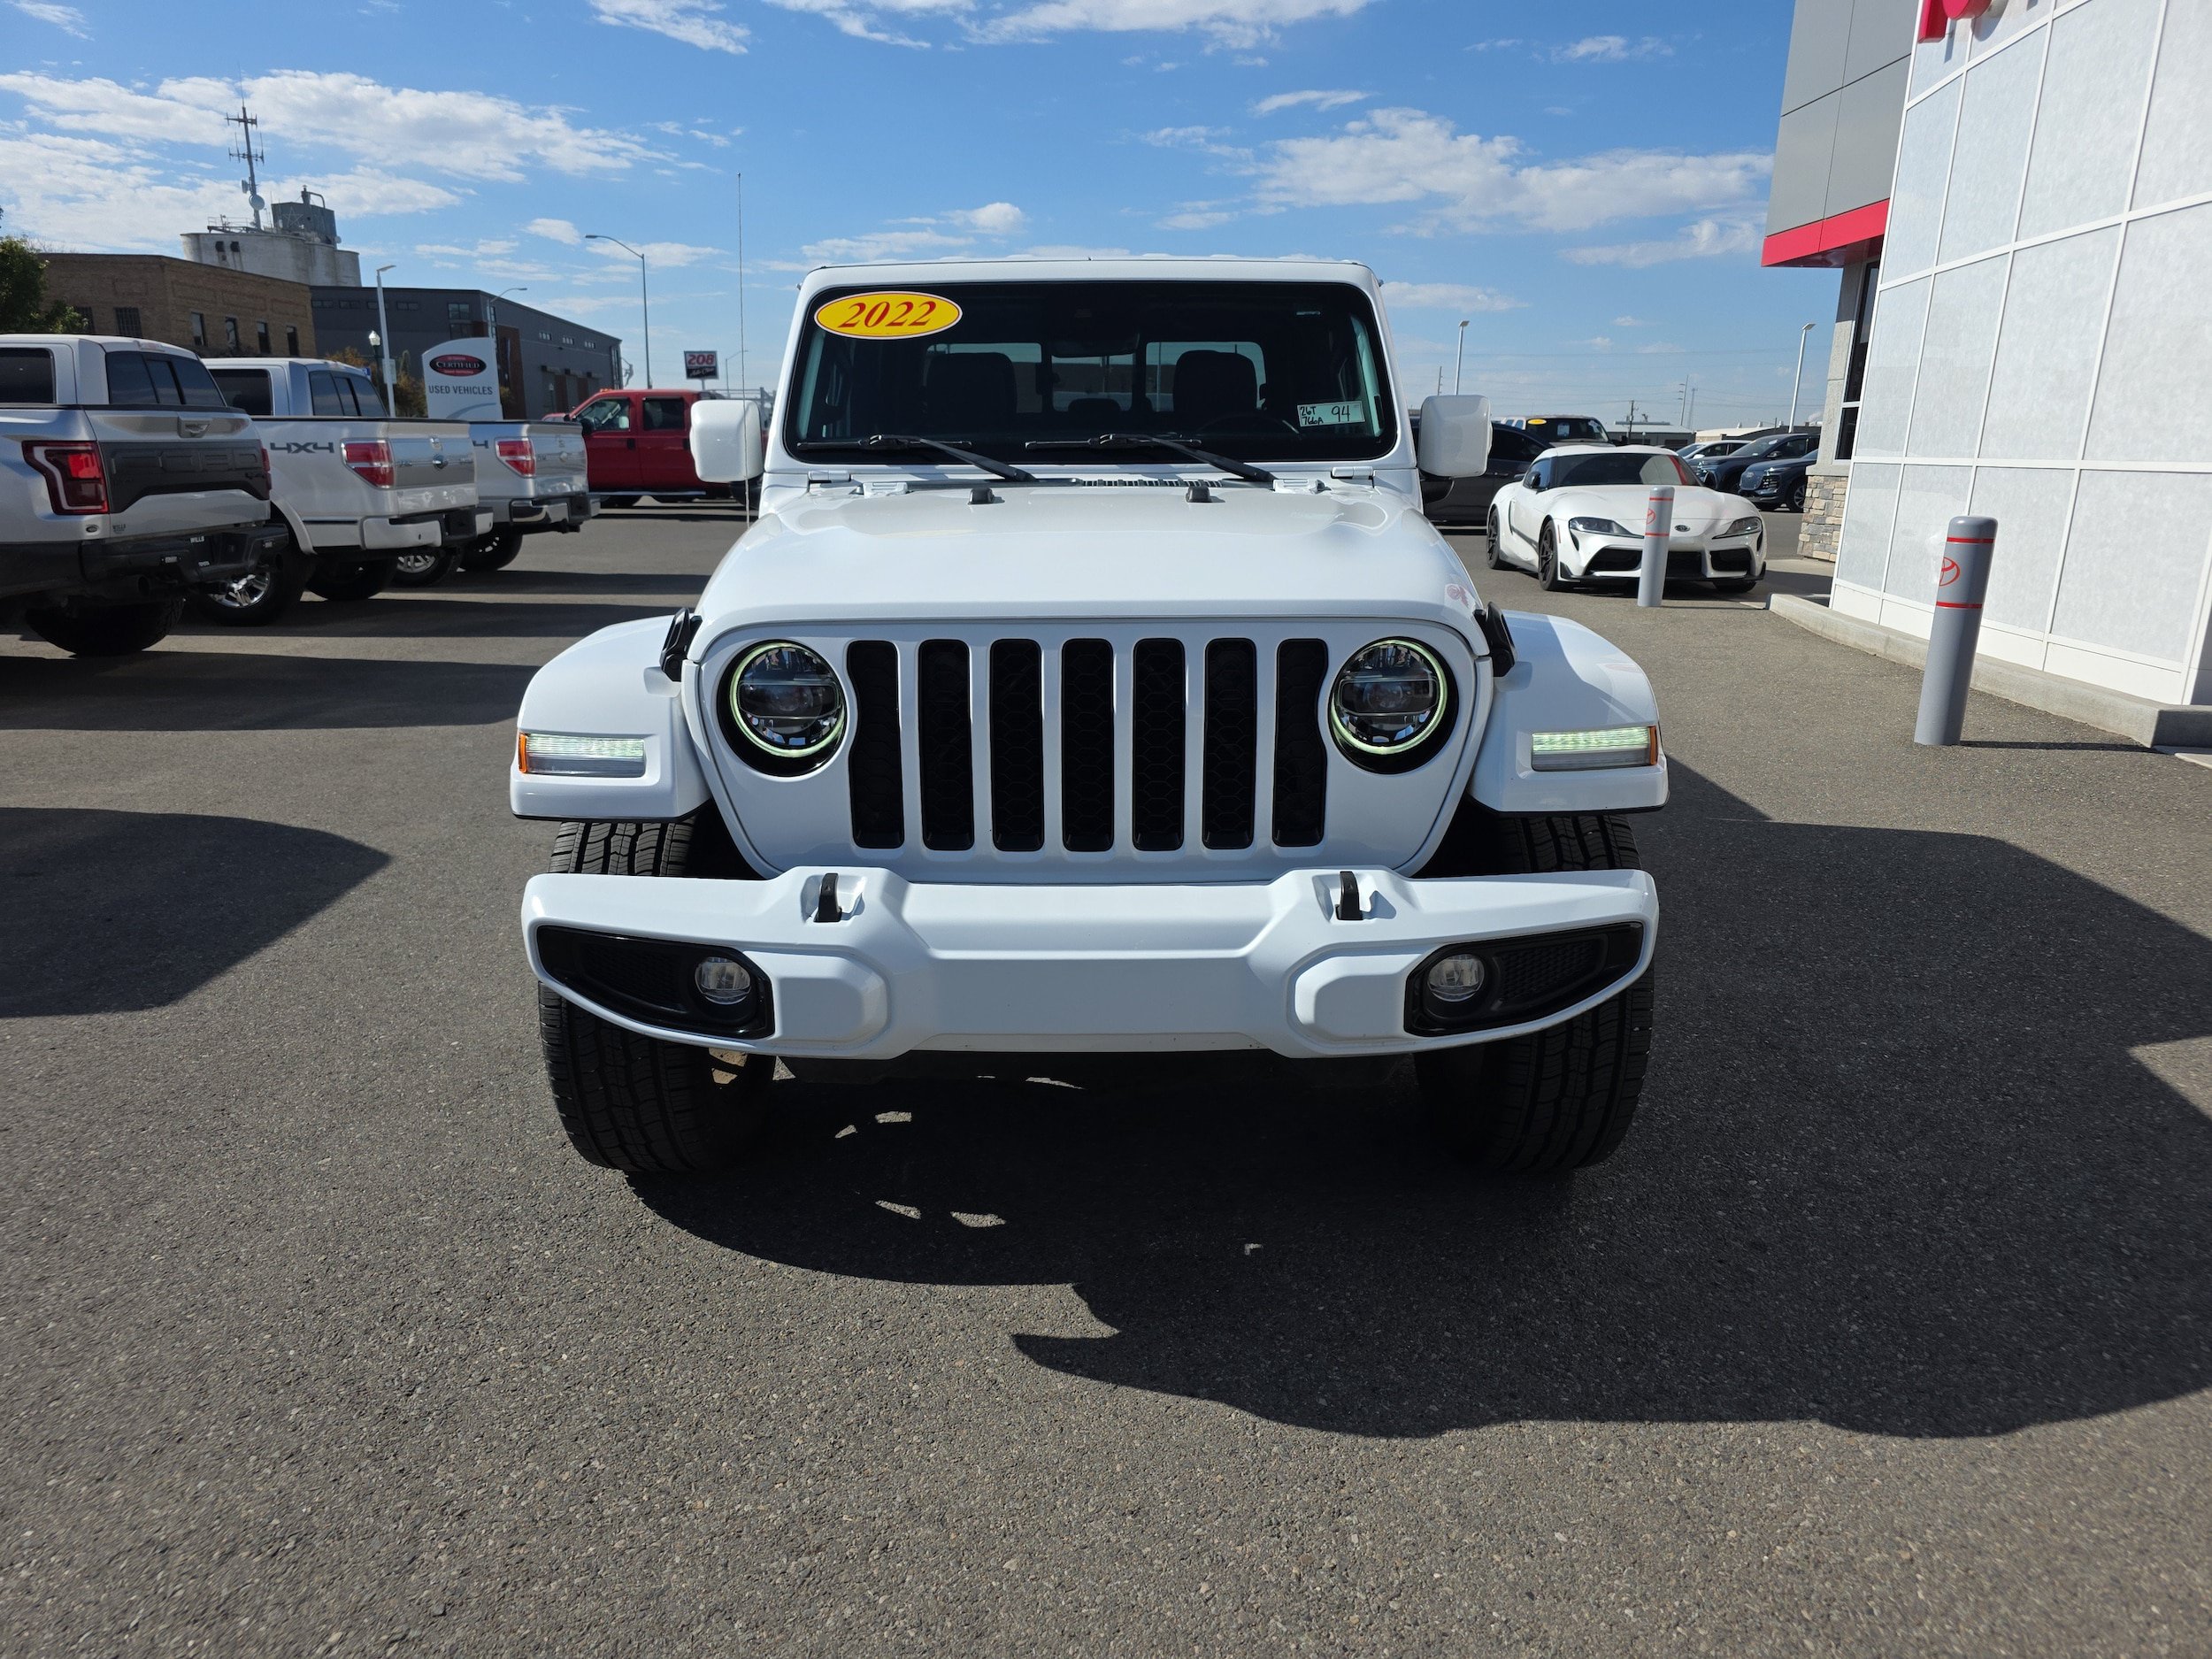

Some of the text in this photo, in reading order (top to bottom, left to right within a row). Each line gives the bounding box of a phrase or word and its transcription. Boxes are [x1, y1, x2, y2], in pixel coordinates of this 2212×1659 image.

[838, 301, 936, 328] 2022
[688, 355, 714, 365] 208
[1331, 405, 1351, 422] 94
[270, 442, 334, 454] 4X4
